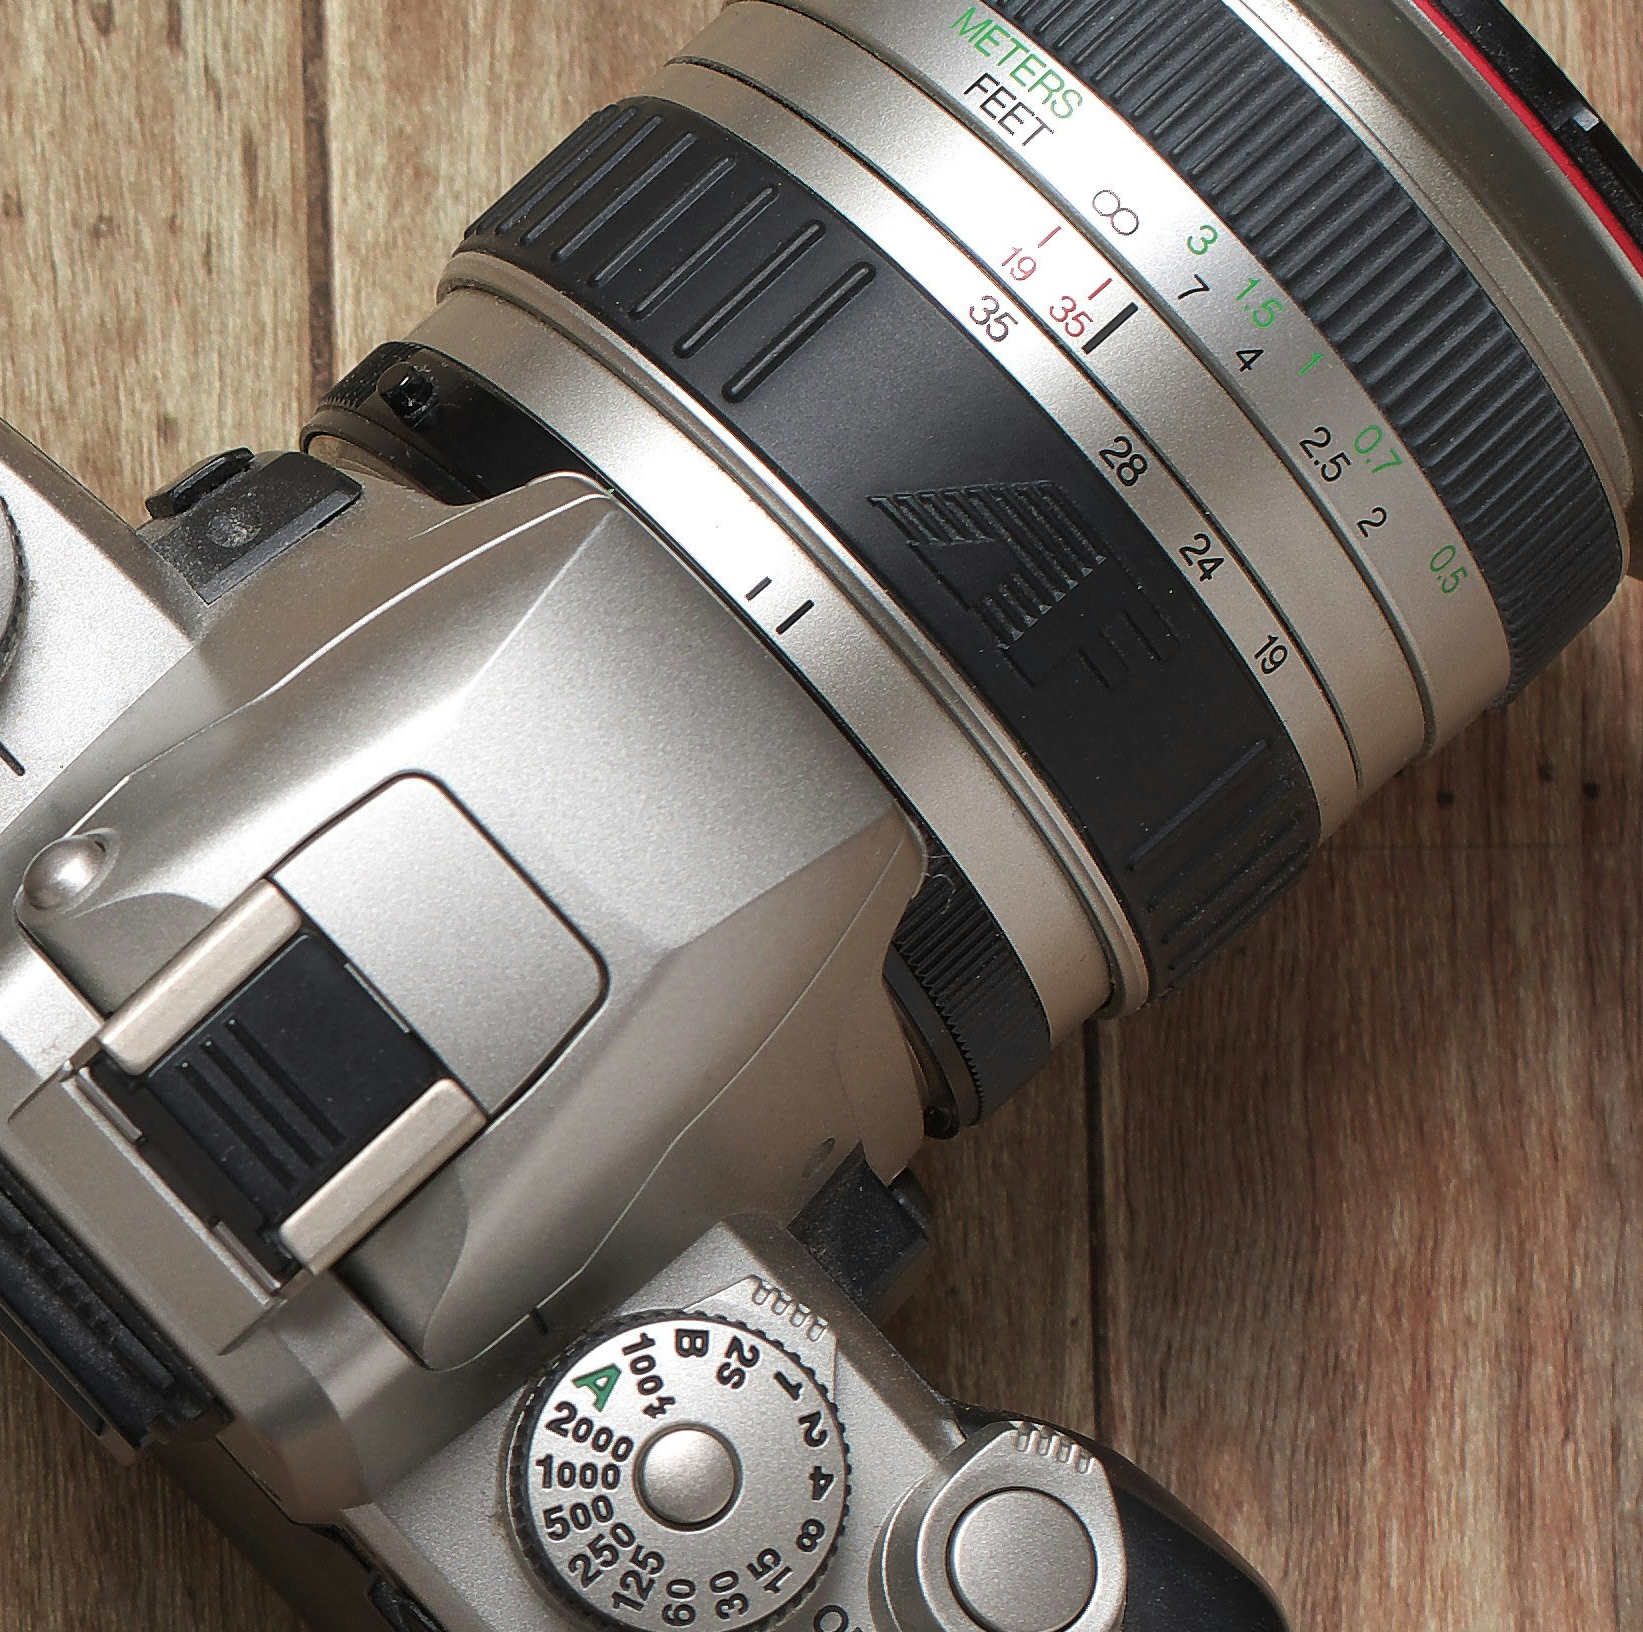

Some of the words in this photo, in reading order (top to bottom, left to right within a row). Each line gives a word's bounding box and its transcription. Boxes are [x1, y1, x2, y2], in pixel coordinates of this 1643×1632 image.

[951, 6, 1083, 119] METERS
[1187, 224, 1218, 255] 3
[1236, 277, 1285, 328] 1.5
[1298, 351, 1324, 376] 1
[1353, 424, 1403, 476] 0.7
[1428, 543, 1470, 595] 0.5
[964, 72, 1054, 146] FEET
[1178, 274, 1211, 300] 7
[1235, 349, 1264, 372] 4
[1299, 426, 1353, 483] 2.5
[1355, 506, 1388, 539] 2
[1001, 245, 1037, 281] 19
[1049, 295, 1094, 337] 35
[969, 295, 1018, 342] 35
[1099, 435, 1148, 487] 28
[1179, 531, 1226, 583] 24
[1252, 633, 1290, 675] 19
[622, 1332, 664, 1396] 100
[675, 1328, 710, 1358] B
[715, 1336, 761, 1390] 2S
[572, 1363, 622, 1412] A
[773, 1371, 803, 1401] 1
[545, 1400, 634, 1463] 2000
[798, 1411, 828, 1448] 2
[535, 1454, 621, 1491] 1000
[808, 1465, 835, 1501] 4
[543, 1495, 614, 1541] 500
[795, 1518, 825, 1553] 8
[568, 1521, 636, 1590] 250
[612, 1544, 665, 1612] 125
[746, 1547, 793, 1595] 15
[661, 1578, 697, 1628] 60
[709, 1570, 749, 1620] 30
